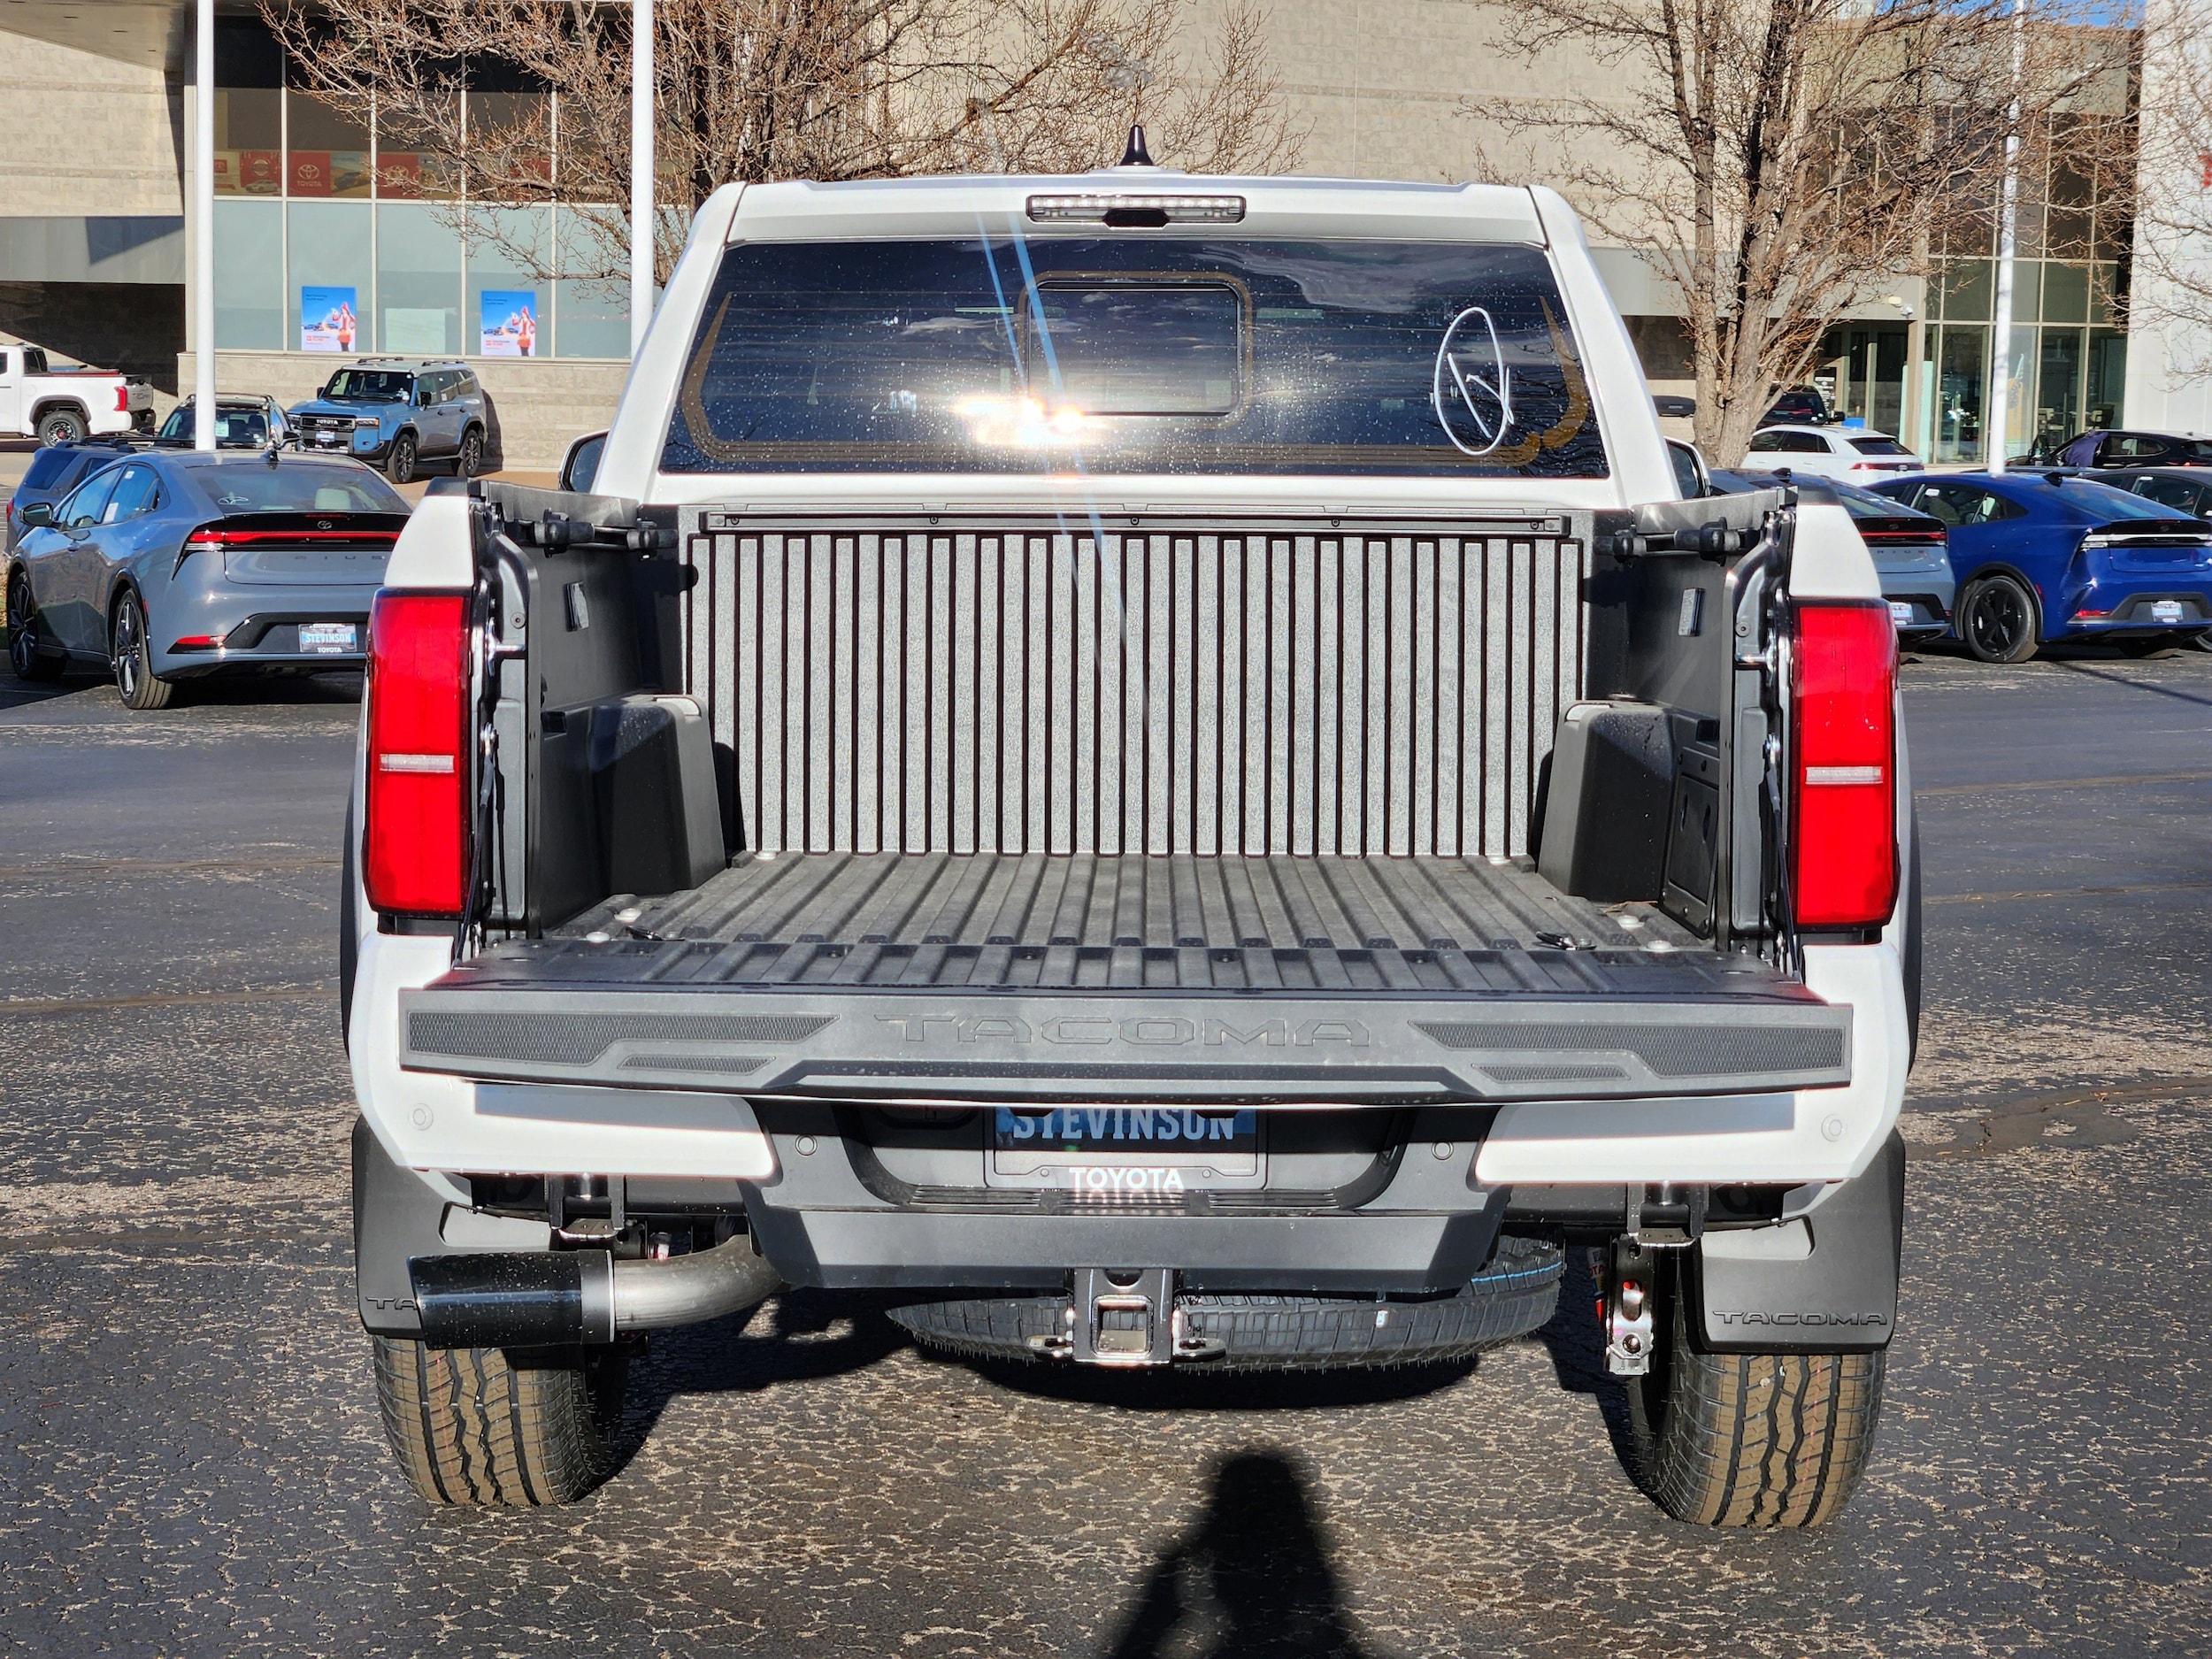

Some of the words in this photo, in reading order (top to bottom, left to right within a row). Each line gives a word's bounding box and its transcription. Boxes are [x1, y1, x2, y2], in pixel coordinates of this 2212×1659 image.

[305, 633, 351, 643] STEVINSON
[873, 1014, 1370, 1048] TACOMA
[1069, 1167, 1185, 1189] TOYOTA
[1712, 1310, 1888, 1325] TACOMA
